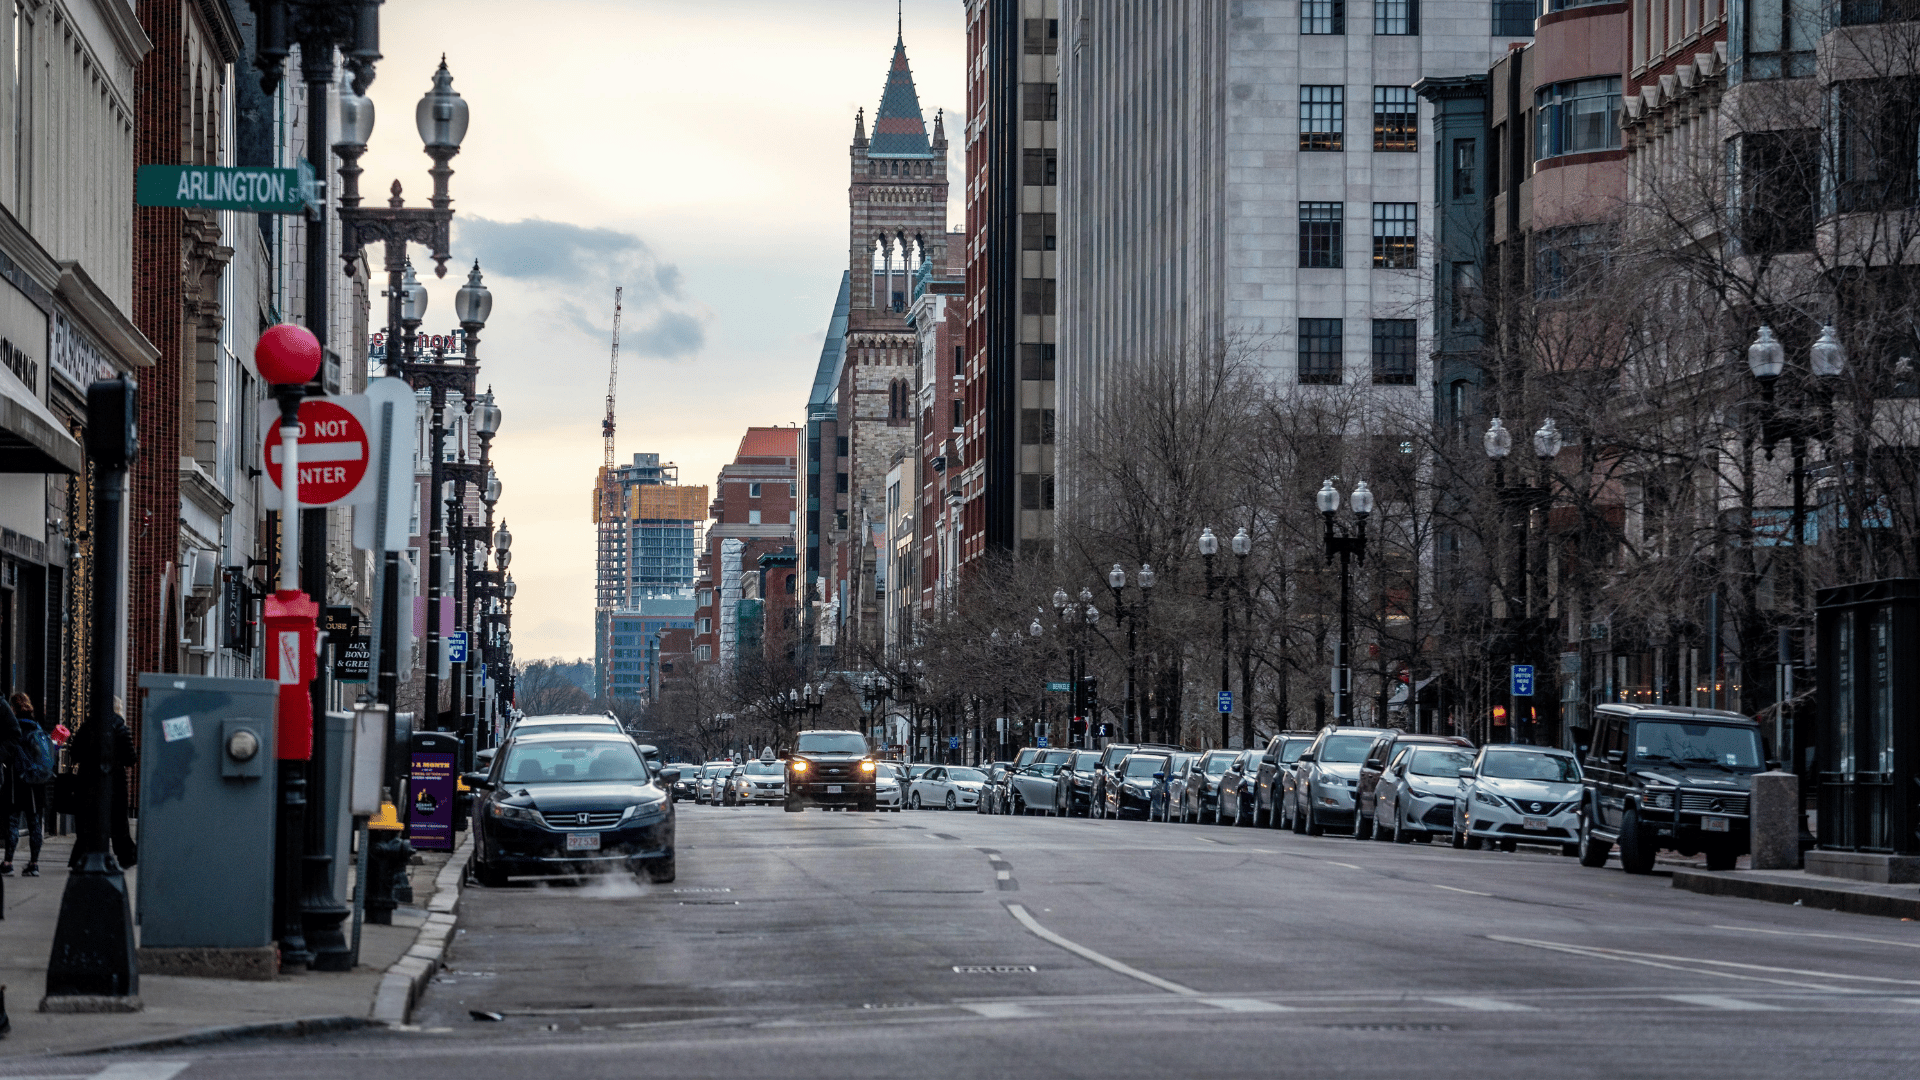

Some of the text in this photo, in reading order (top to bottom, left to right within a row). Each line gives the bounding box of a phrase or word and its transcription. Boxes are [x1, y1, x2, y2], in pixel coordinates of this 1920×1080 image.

[176, 170, 285, 203] ARLINGTON
[314, 420, 348, 437] NOT
[298, 466, 346, 485] NTER
[348, 642, 367, 650] LUX
[345, 651, 370, 659] BOND
[345, 660, 370, 668] GREE
